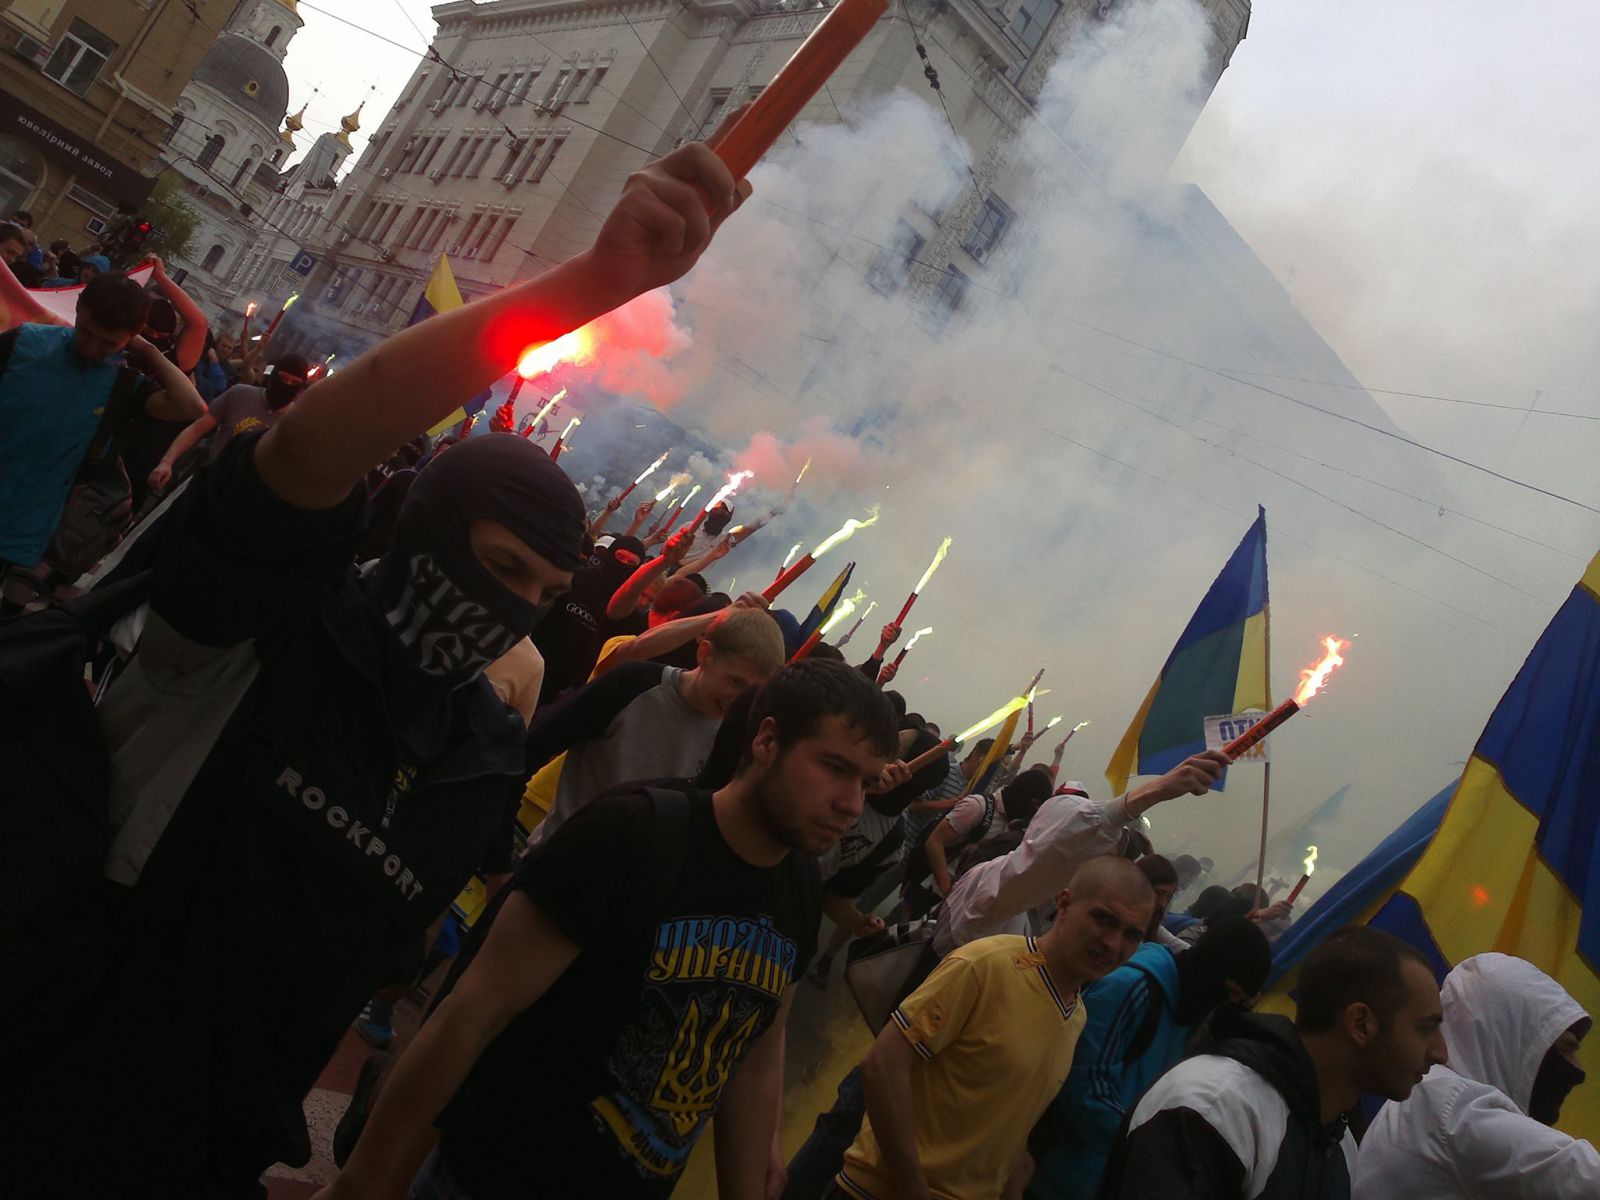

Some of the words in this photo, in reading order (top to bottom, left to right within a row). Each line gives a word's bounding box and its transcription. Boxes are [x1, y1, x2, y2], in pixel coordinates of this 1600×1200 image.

[17, 114, 80, 157] ювелірний
[81, 151, 114, 178] завод
[295, 254, 312, 270] P
[276, 766, 424, 901] ROCKPORT
